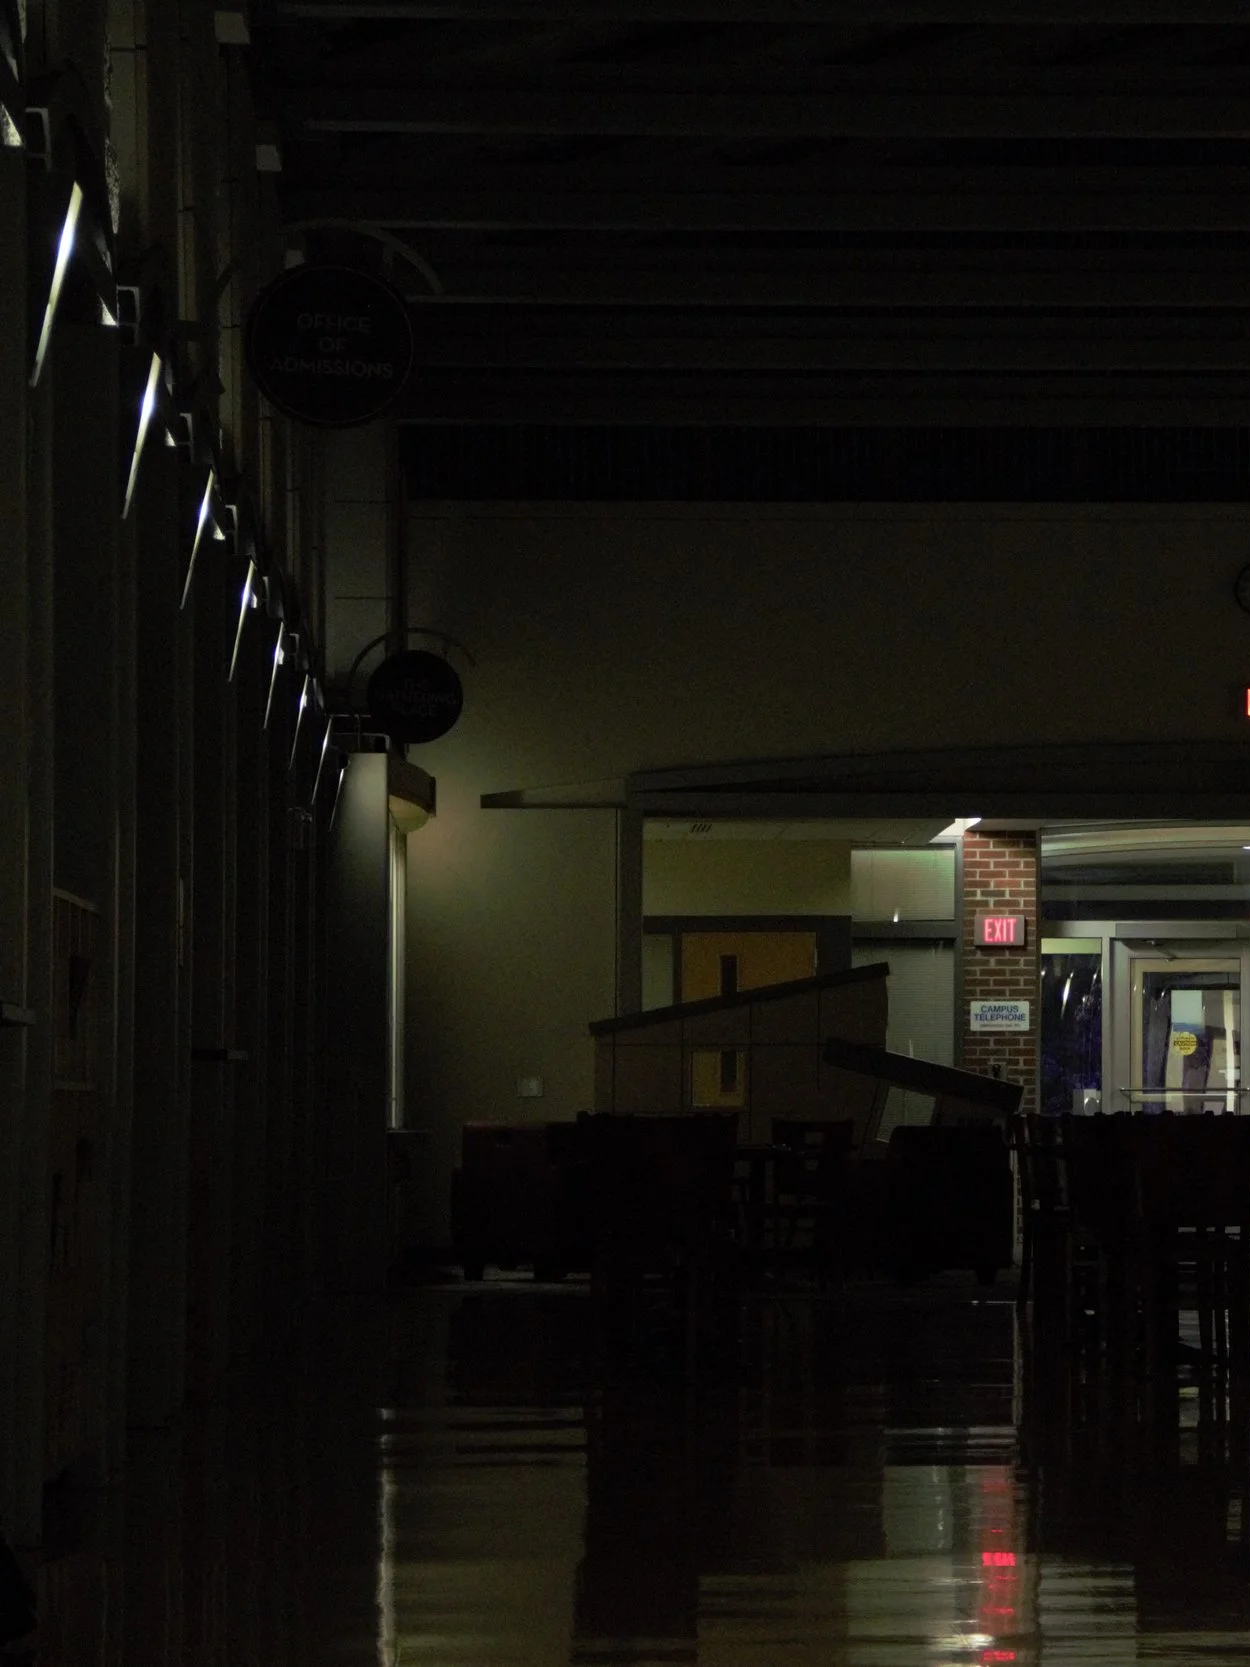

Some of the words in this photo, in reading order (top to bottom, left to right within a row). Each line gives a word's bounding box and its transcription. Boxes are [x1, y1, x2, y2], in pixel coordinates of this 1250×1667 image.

[297, 312, 372, 334] OFFICE
[318, 336, 347, 352] OF
[269, 356, 393, 379] ADMISSIONS
[984, 918, 1016, 943] EXIT
[974, 1013, 1026, 1021] TELEPHONE
[980, 1005, 1019, 1013] CAMPUS
